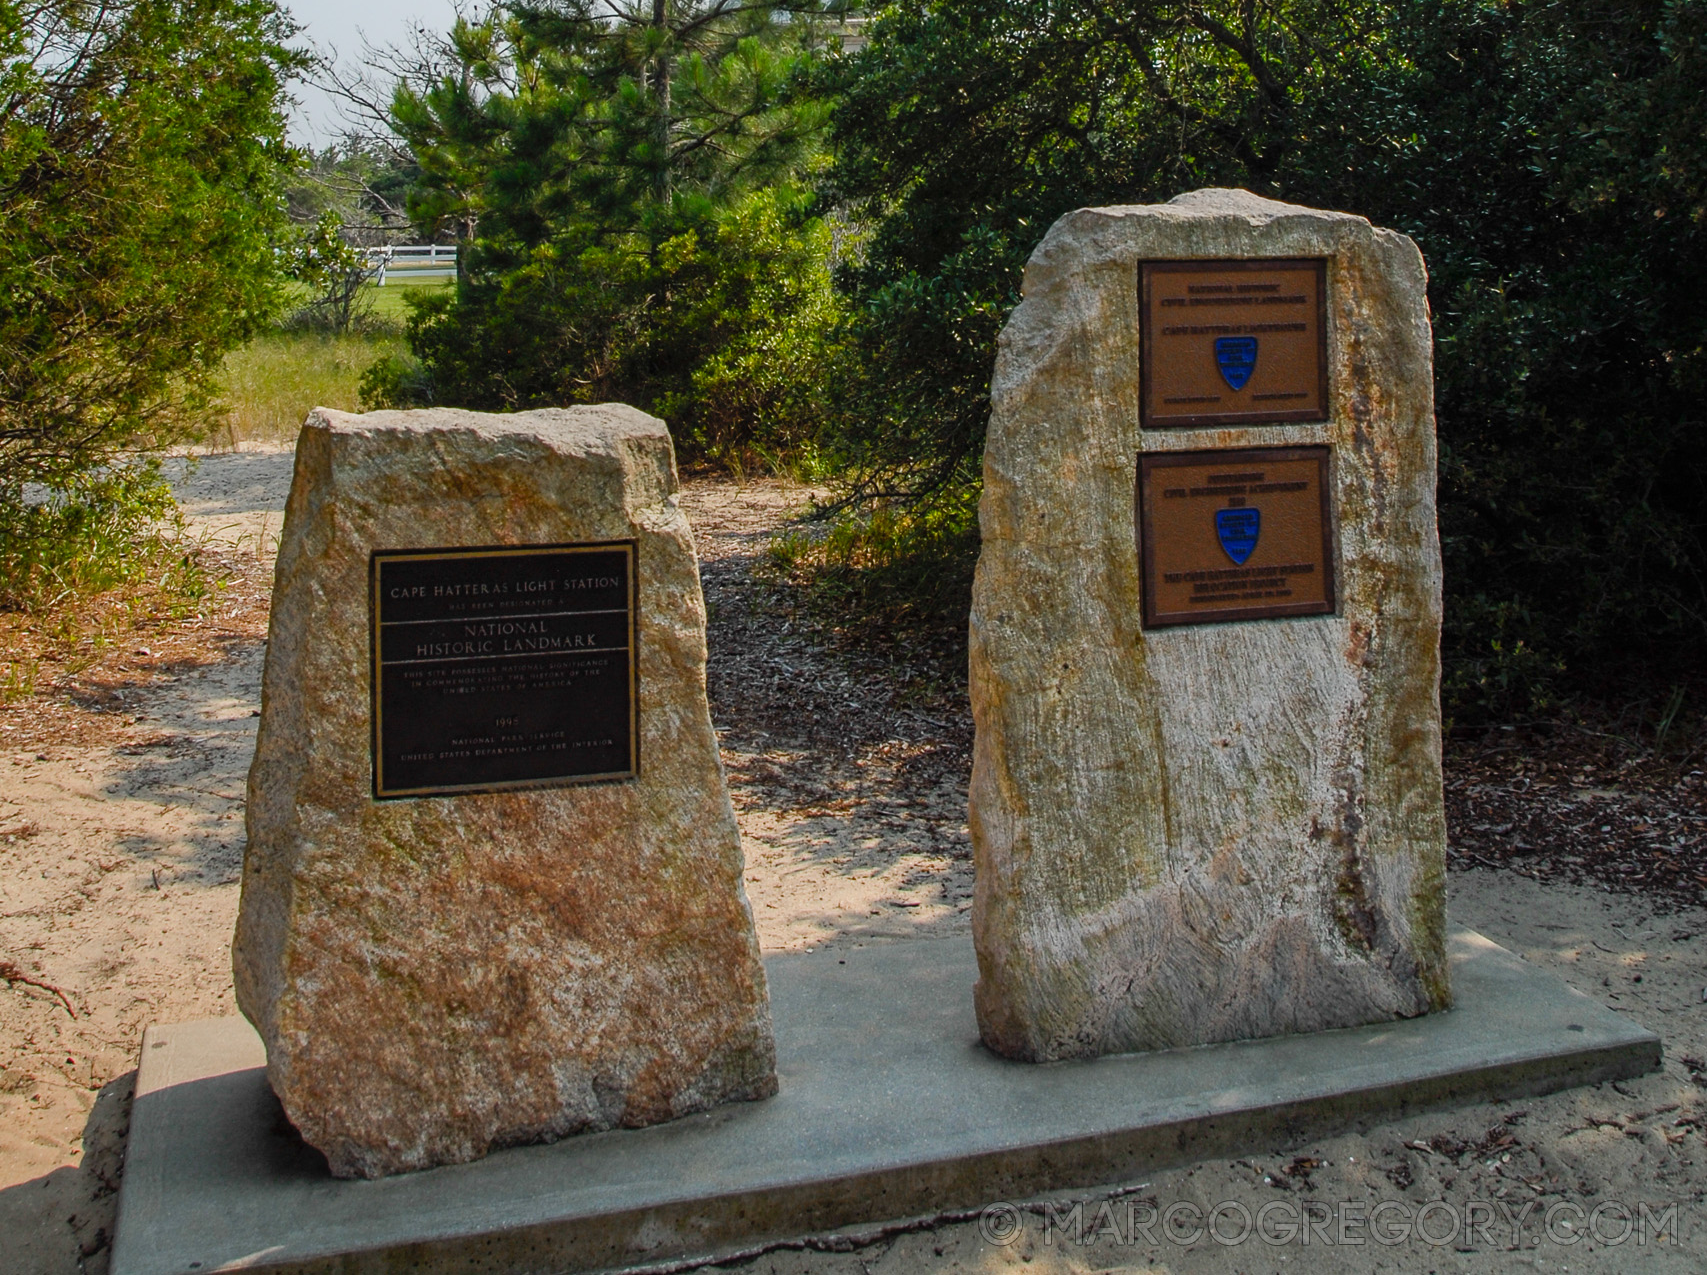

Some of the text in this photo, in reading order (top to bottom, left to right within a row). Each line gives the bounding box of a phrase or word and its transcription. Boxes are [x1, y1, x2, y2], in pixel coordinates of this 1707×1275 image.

[390, 577, 619, 598] CAPE HATTERAS LIGHT STATION
[464, 621, 547, 637] NATIONAL
[416, 634, 596, 656] HISTORIC LANDMARK
[451, 737, 495, 745] NATIONAL
